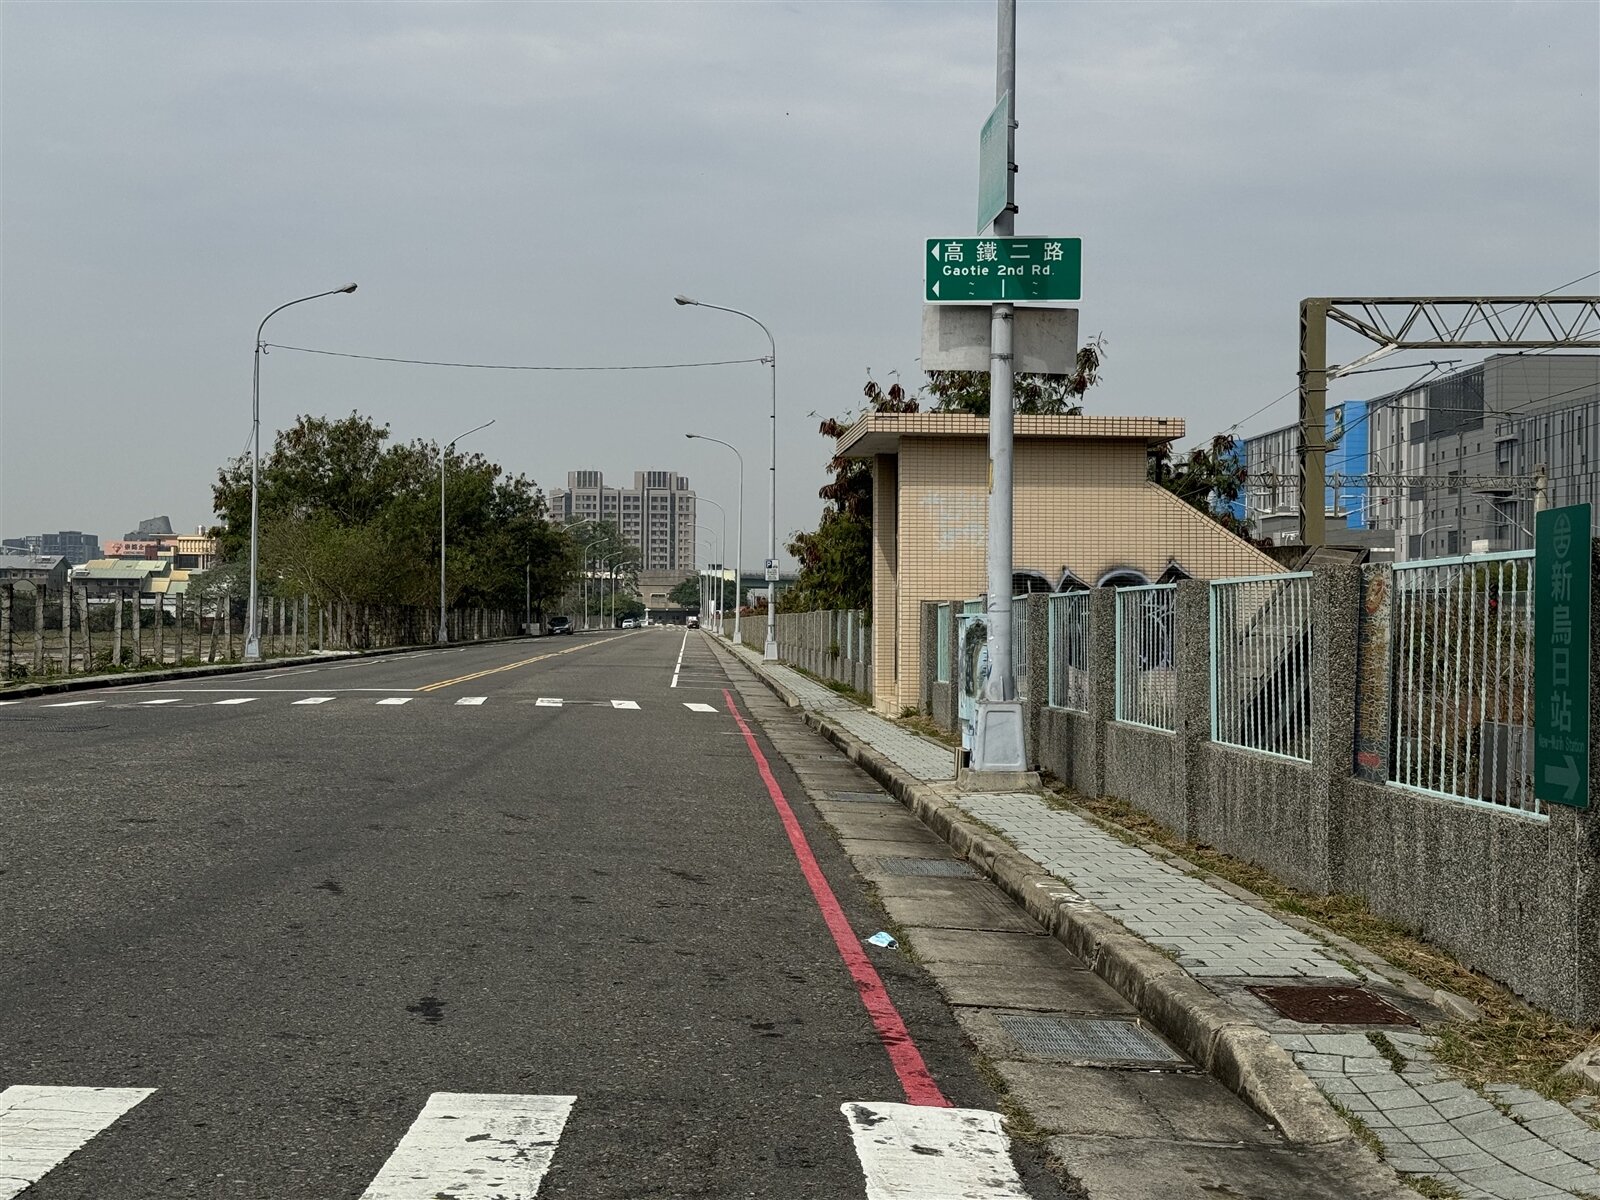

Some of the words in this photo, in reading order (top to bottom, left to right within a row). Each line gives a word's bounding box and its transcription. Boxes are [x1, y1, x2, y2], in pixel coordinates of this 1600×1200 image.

[944, 241, 1064, 262] 高鐵二路
[942, 265, 989, 276] Gaotie
[997, 265, 1024, 276] 2nd
[1031, 265, 1055, 276] Rd.
[1551, 560, 1573, 733] 新烏日站
[1565, 736, 1585, 753] Station
